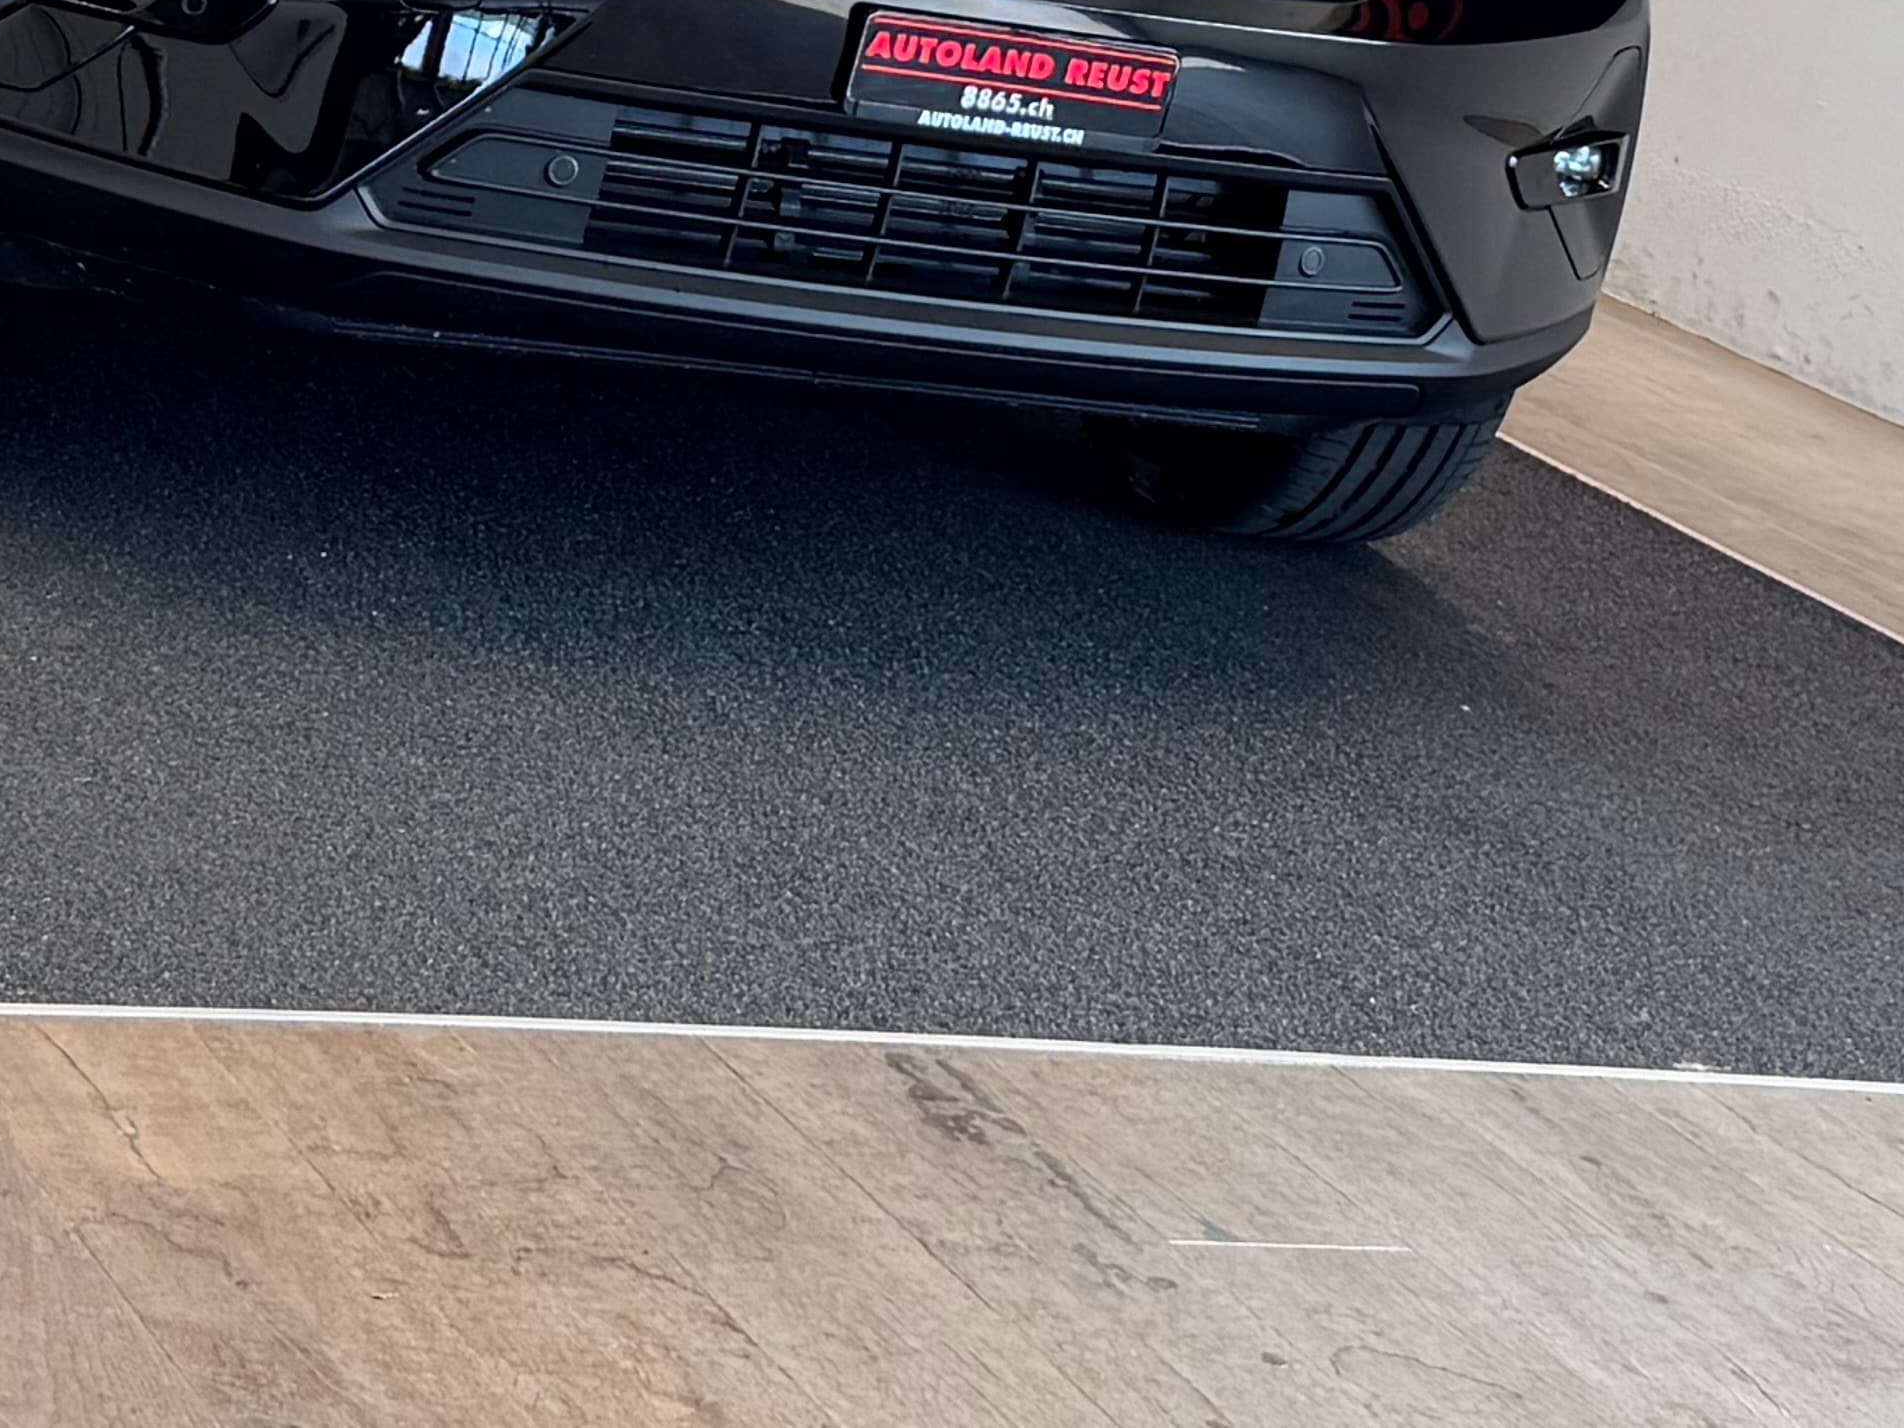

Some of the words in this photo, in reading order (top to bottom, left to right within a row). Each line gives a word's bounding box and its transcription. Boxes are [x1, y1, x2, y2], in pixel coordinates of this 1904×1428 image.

[865, 30, 1056, 81] AUTOLAND
[1063, 58, 1172, 99] REUST
[960, 85, 1055, 120] 8865.ch
[917, 109, 1085, 146] AUTOLAND-REUST.CH
